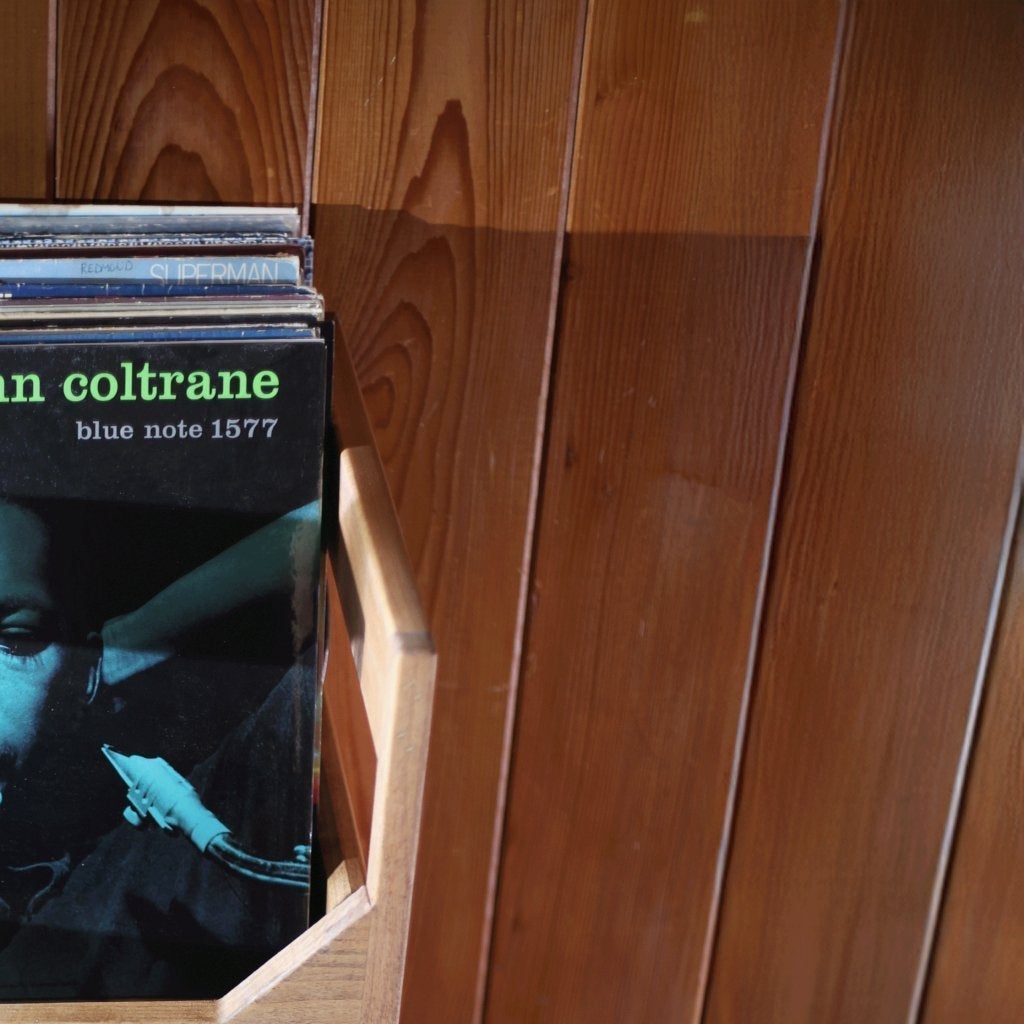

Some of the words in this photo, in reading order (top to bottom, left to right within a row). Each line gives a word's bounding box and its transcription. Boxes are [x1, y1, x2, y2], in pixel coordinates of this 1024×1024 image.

[150, 262, 278, 285] SUPERMAN
[62, 362, 280, 402] coltrane
[76, 420, 134, 440] blue
[144, 422, 203, 439] note
[211, 418, 279, 439] 1577
